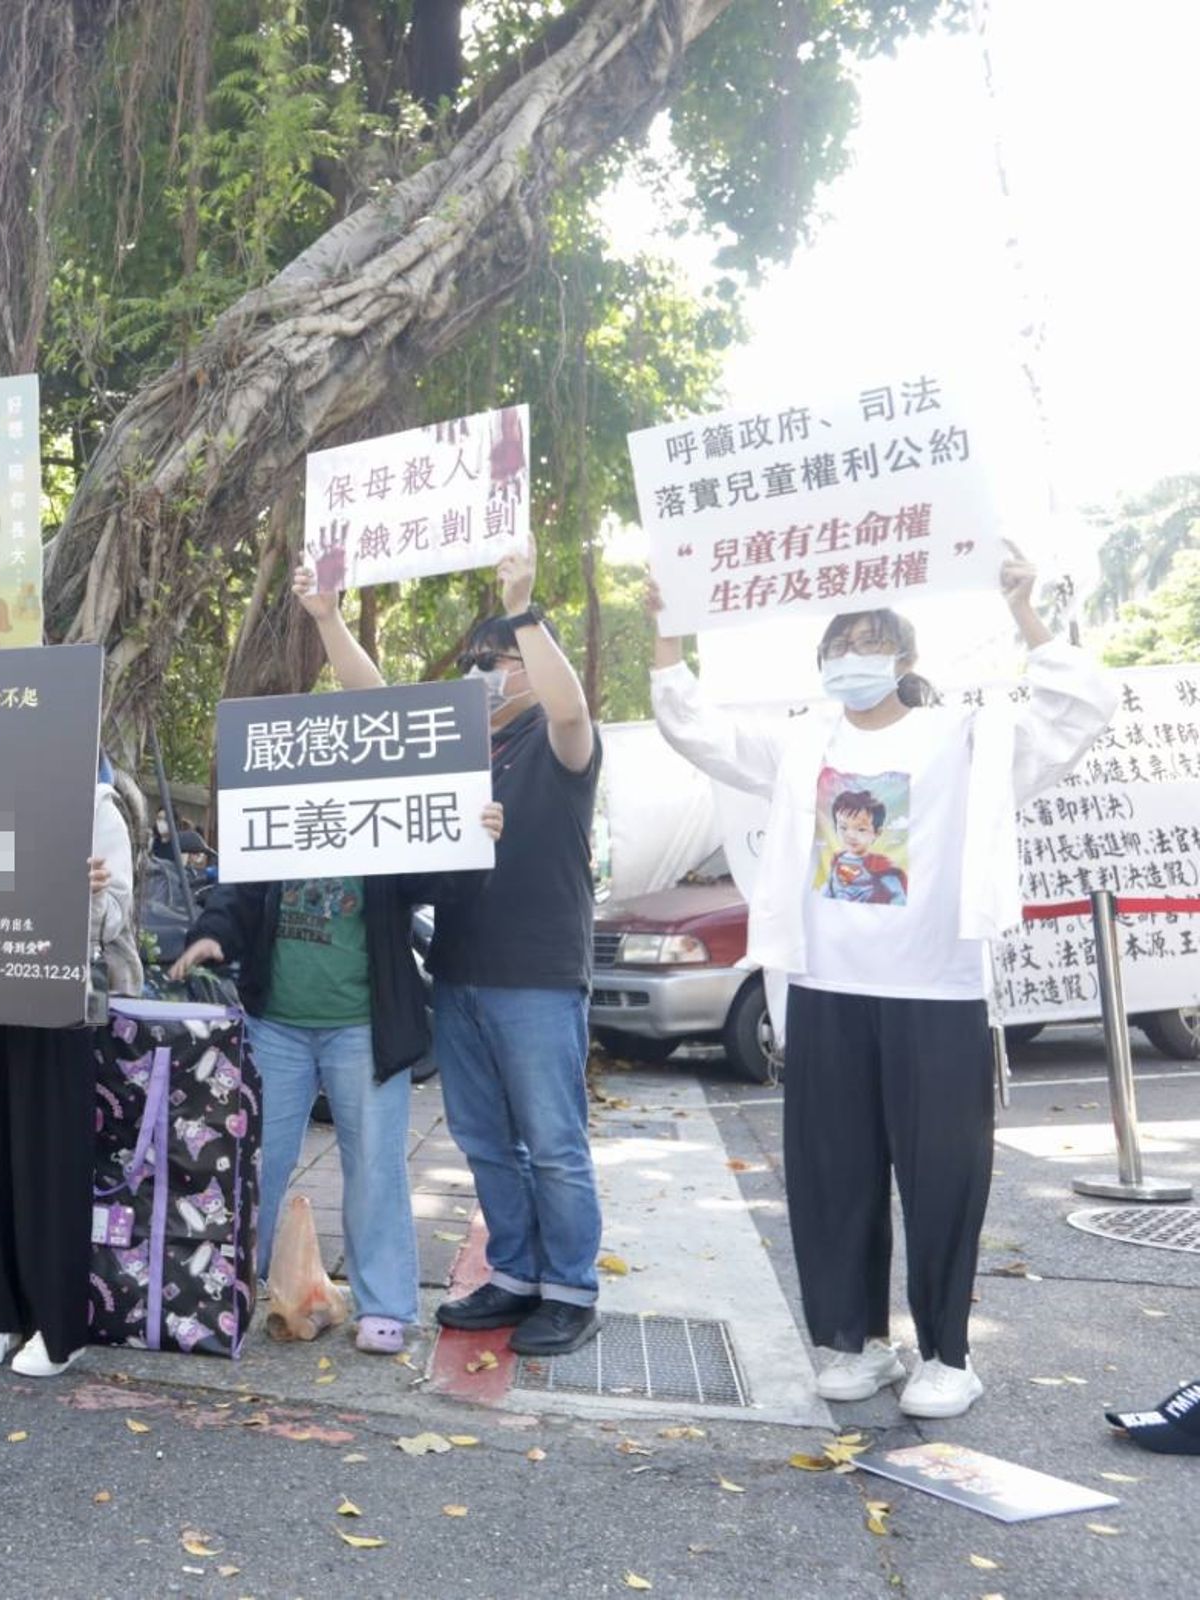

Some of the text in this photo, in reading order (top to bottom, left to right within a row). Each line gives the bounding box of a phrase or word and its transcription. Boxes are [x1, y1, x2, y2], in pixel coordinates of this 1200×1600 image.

[325, 446, 480, 511] 保母殺人
[654, 423, 970, 520] 落實兒童權利公約
[356, 496, 518, 562] 餓死剴剴
[708, 549, 929, 616] 生存及發展權
[243, 705, 461, 773] 嚴懲兇手
[240, 791, 462, 853] 正義不眠
